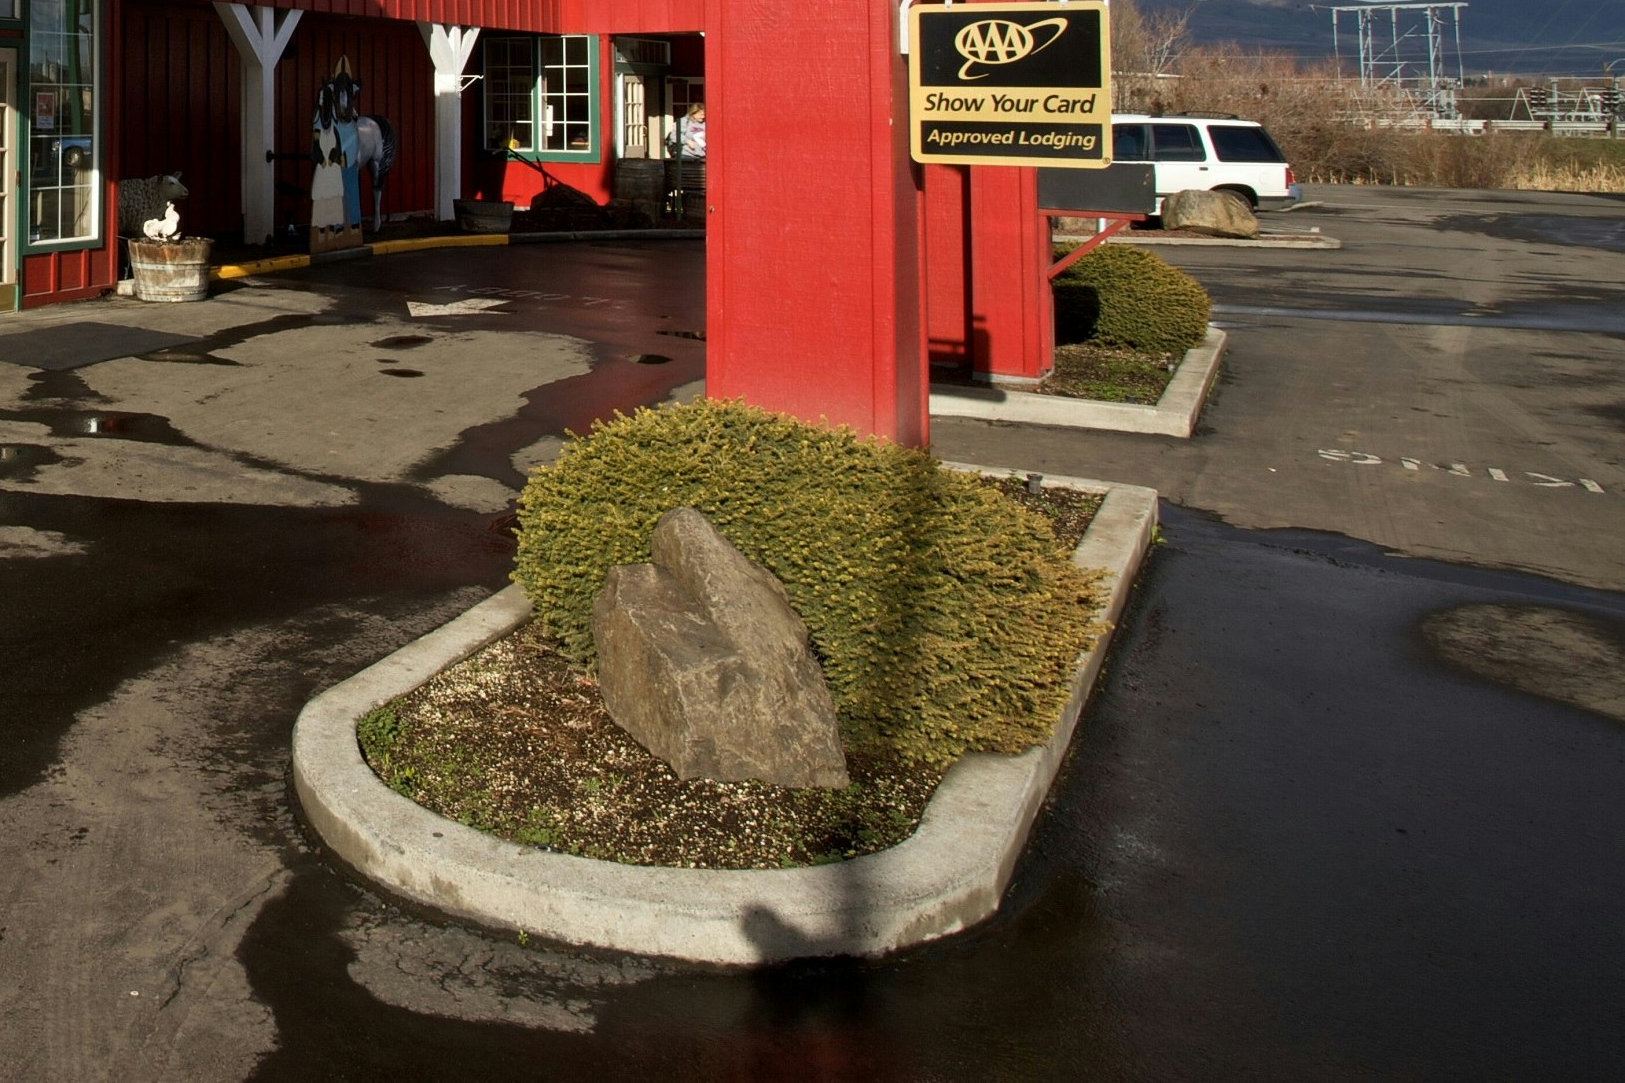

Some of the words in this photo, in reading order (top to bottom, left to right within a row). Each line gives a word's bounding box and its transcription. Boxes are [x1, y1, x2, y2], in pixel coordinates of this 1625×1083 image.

[959, 20, 1031, 63] AAA
[924, 92, 985, 112] Show
[991, 94, 1039, 113] Your
[1043, 94, 1096, 114] Card
[927, 129, 1015, 147] Approved
[1019, 130, 1096, 150] Lodging
